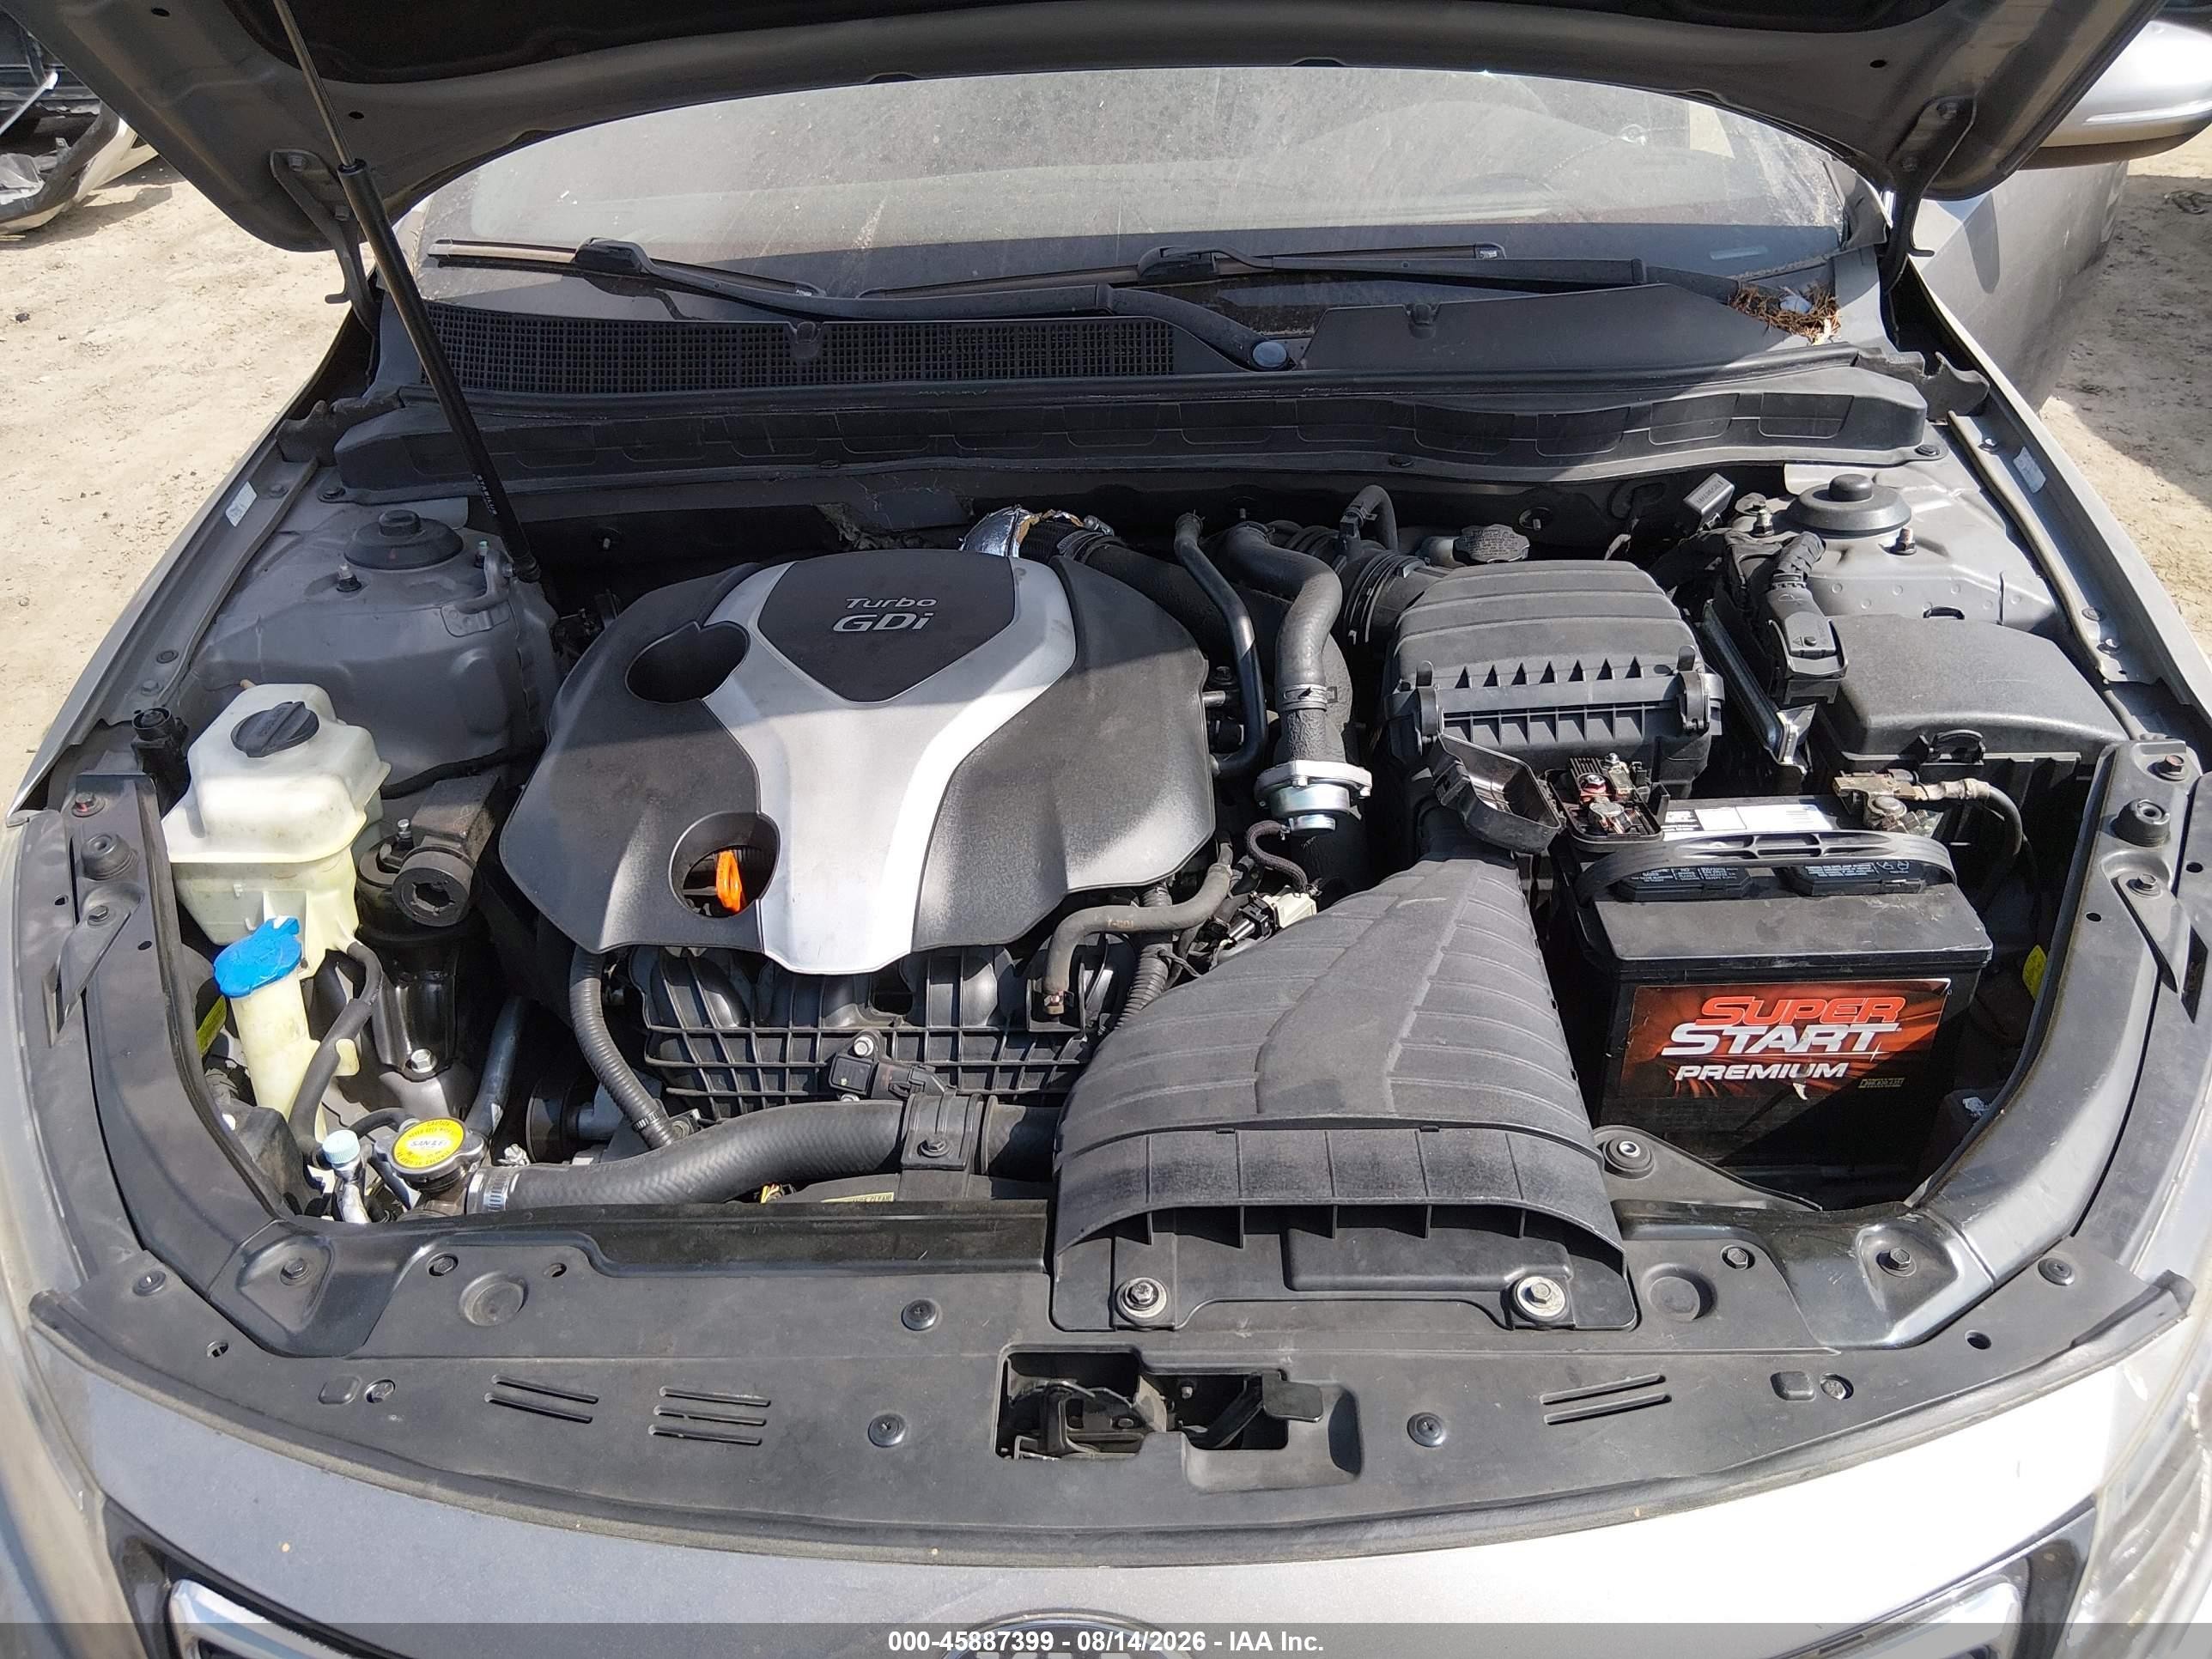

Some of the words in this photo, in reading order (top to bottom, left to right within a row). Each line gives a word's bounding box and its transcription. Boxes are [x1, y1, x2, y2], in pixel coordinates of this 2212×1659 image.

[846, 597, 938, 609] Turbo
[833, 612, 935, 632] GDi
[1696, 996, 1905, 1025] SUPER
[1661, 1023, 1899, 1055] START
[1674, 1062, 1849, 1080] PREMIUM
